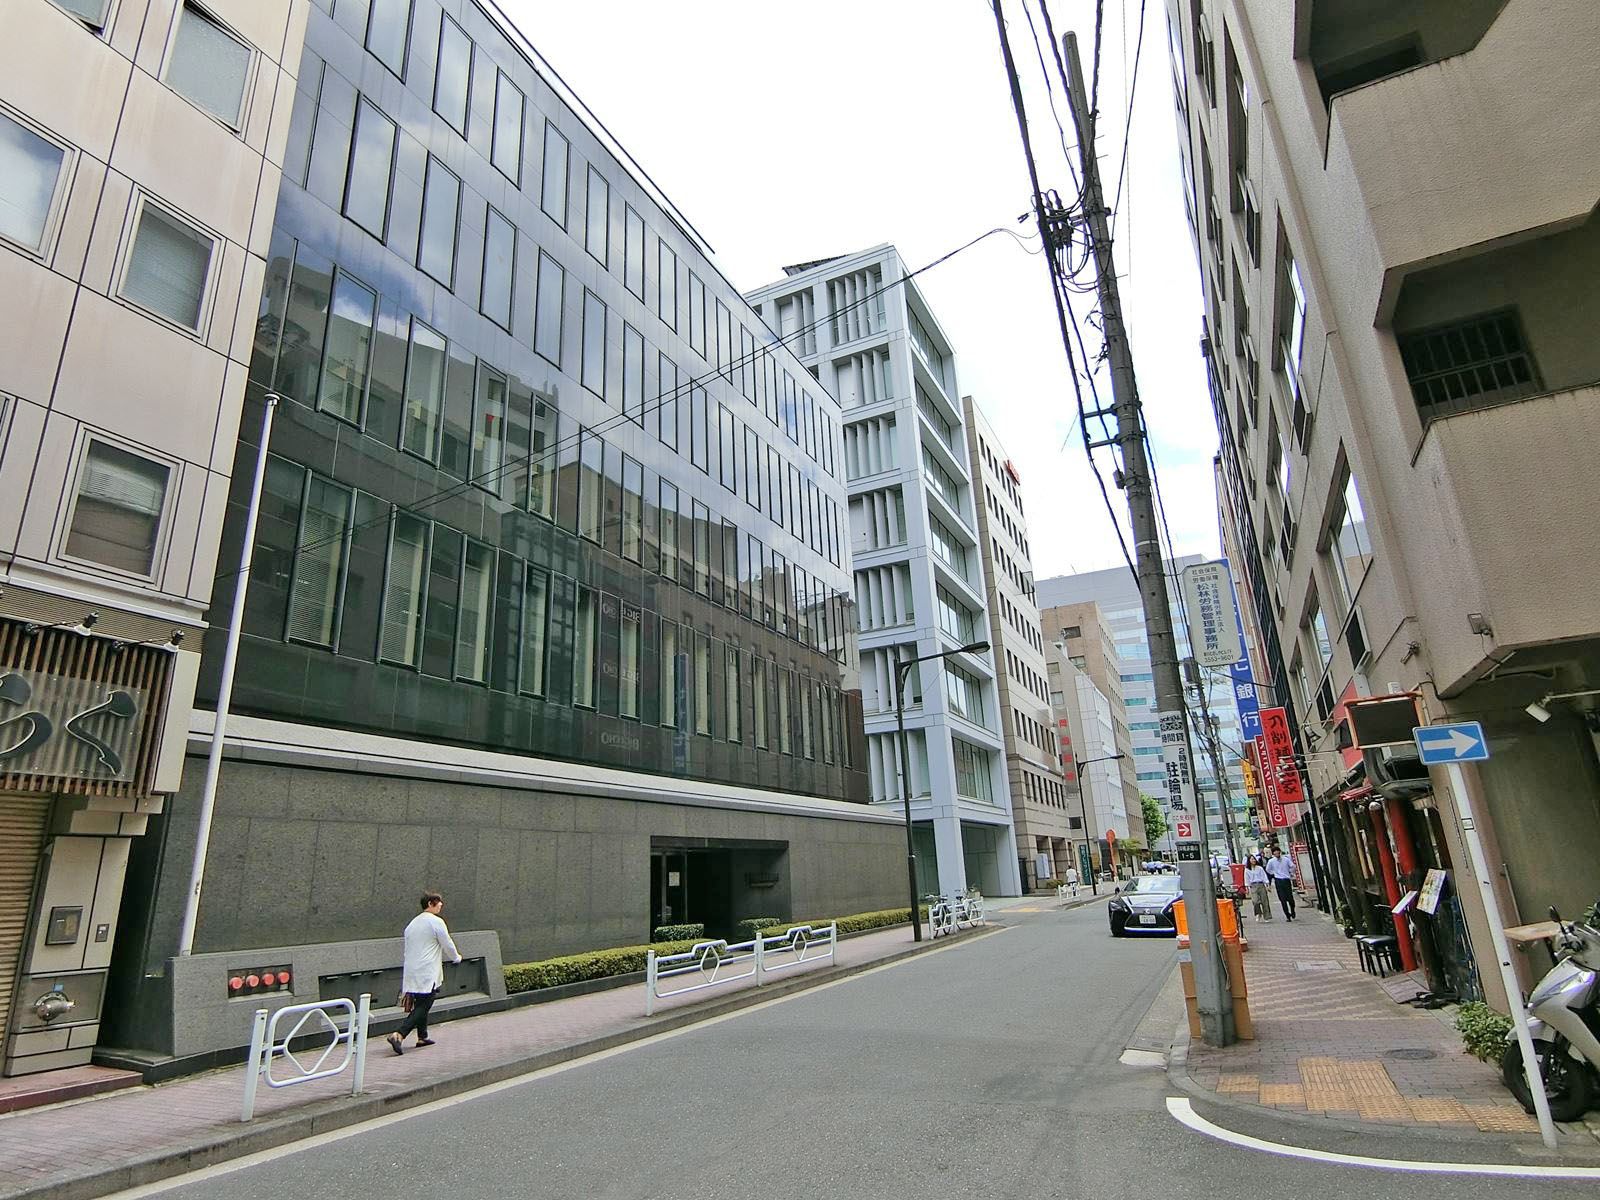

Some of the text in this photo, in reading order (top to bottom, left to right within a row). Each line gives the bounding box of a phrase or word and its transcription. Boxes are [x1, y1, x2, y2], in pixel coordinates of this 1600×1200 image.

[1197, 583, 1219, 650] 松林労務管理事務所
[1166, 761, 1184, 811] 駐輪場
